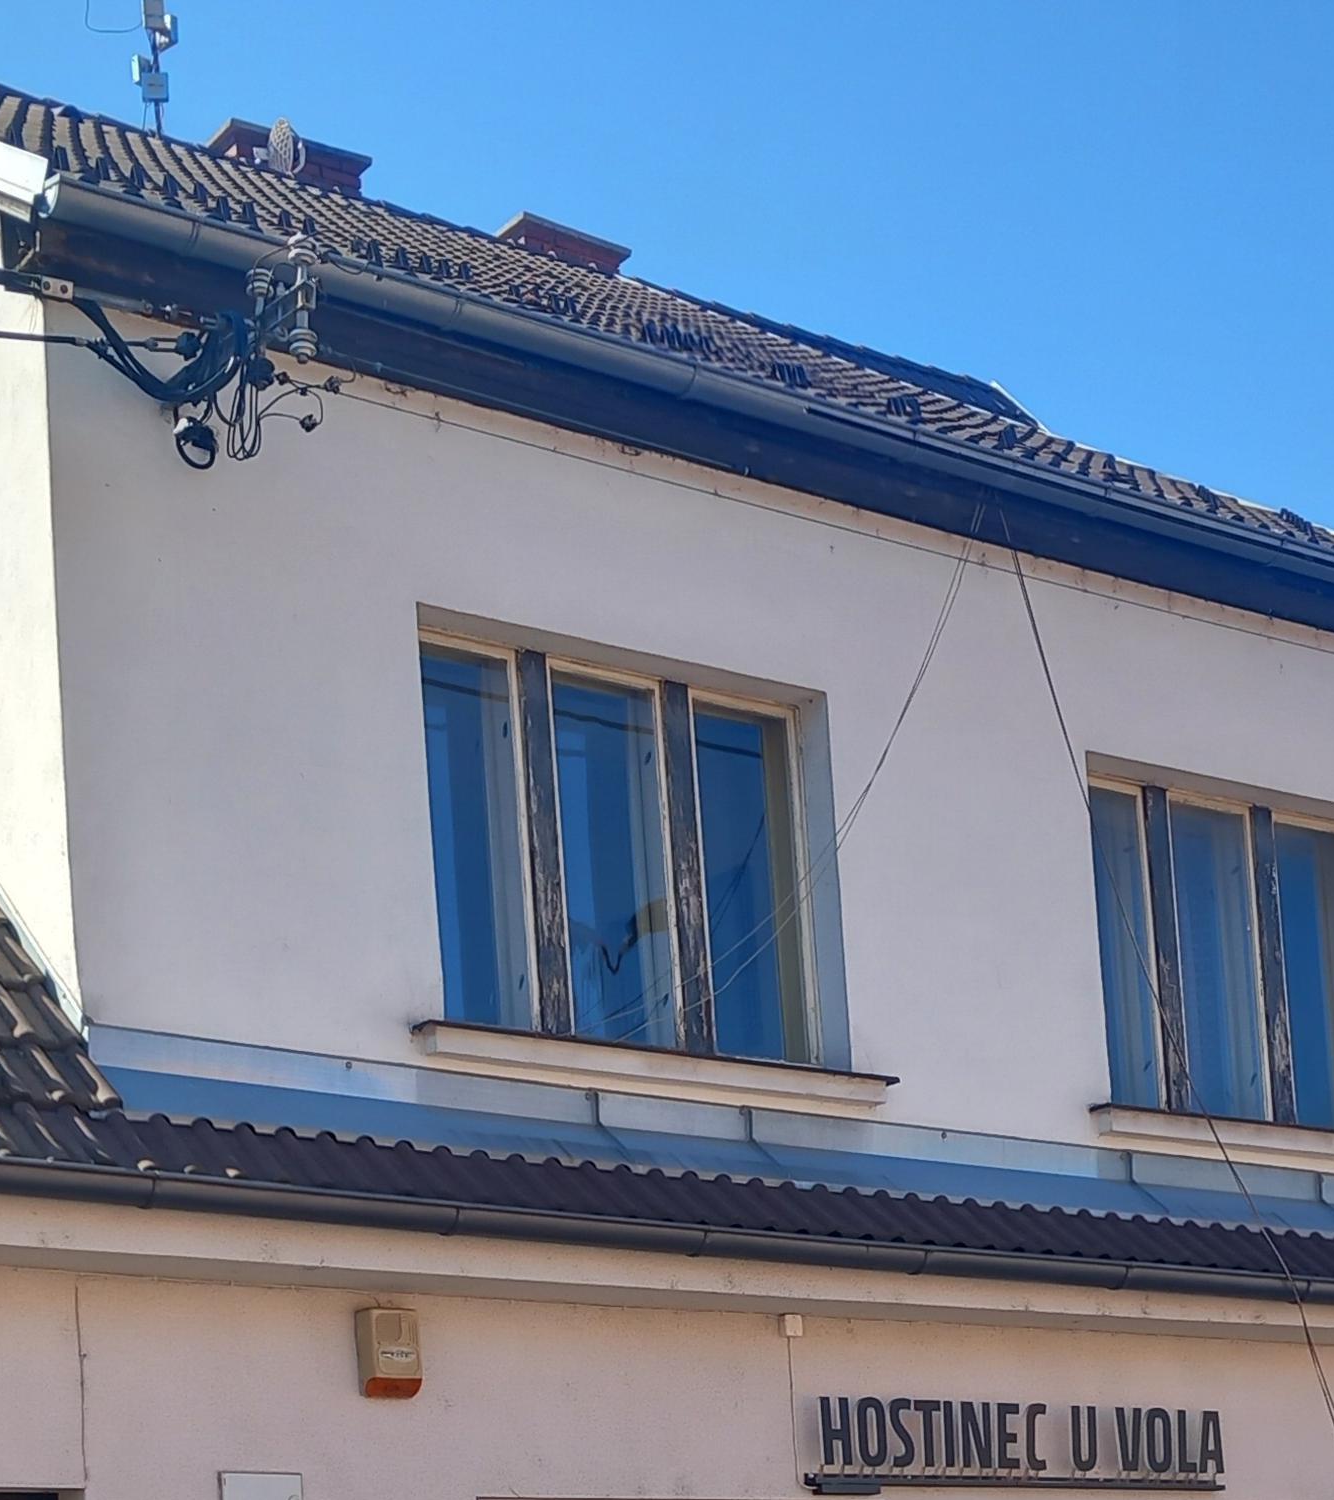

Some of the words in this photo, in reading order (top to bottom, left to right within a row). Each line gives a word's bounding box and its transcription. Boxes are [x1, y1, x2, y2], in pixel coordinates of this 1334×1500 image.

[818, 1396, 1048, 1471] HOSTINEC
[1070, 1405, 1098, 1471] U
[1114, 1407, 1225, 1474] VOLA
